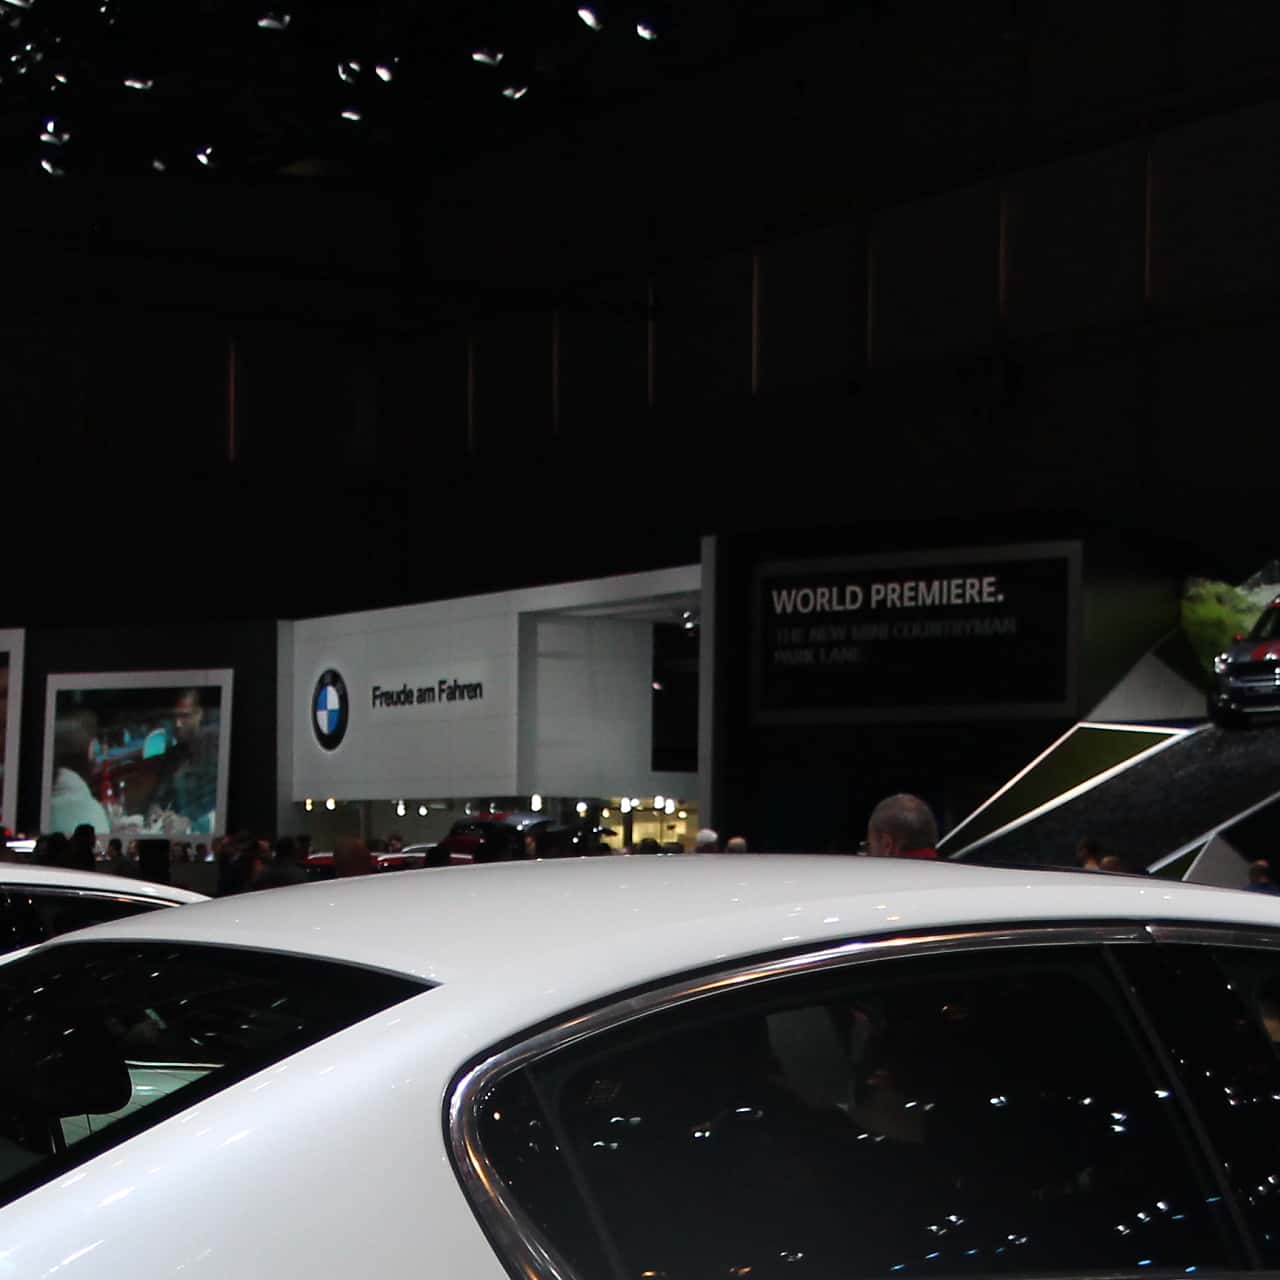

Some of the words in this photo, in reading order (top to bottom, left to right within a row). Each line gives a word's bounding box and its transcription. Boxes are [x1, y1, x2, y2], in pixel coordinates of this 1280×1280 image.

[772, 586, 863, 614] WORLD
[871, 577, 1005, 608] PREMIERE.
[372, 684, 414, 707] Freude
[417, 687, 435, 705] am
[438, 679, 483, 702] Fahren
